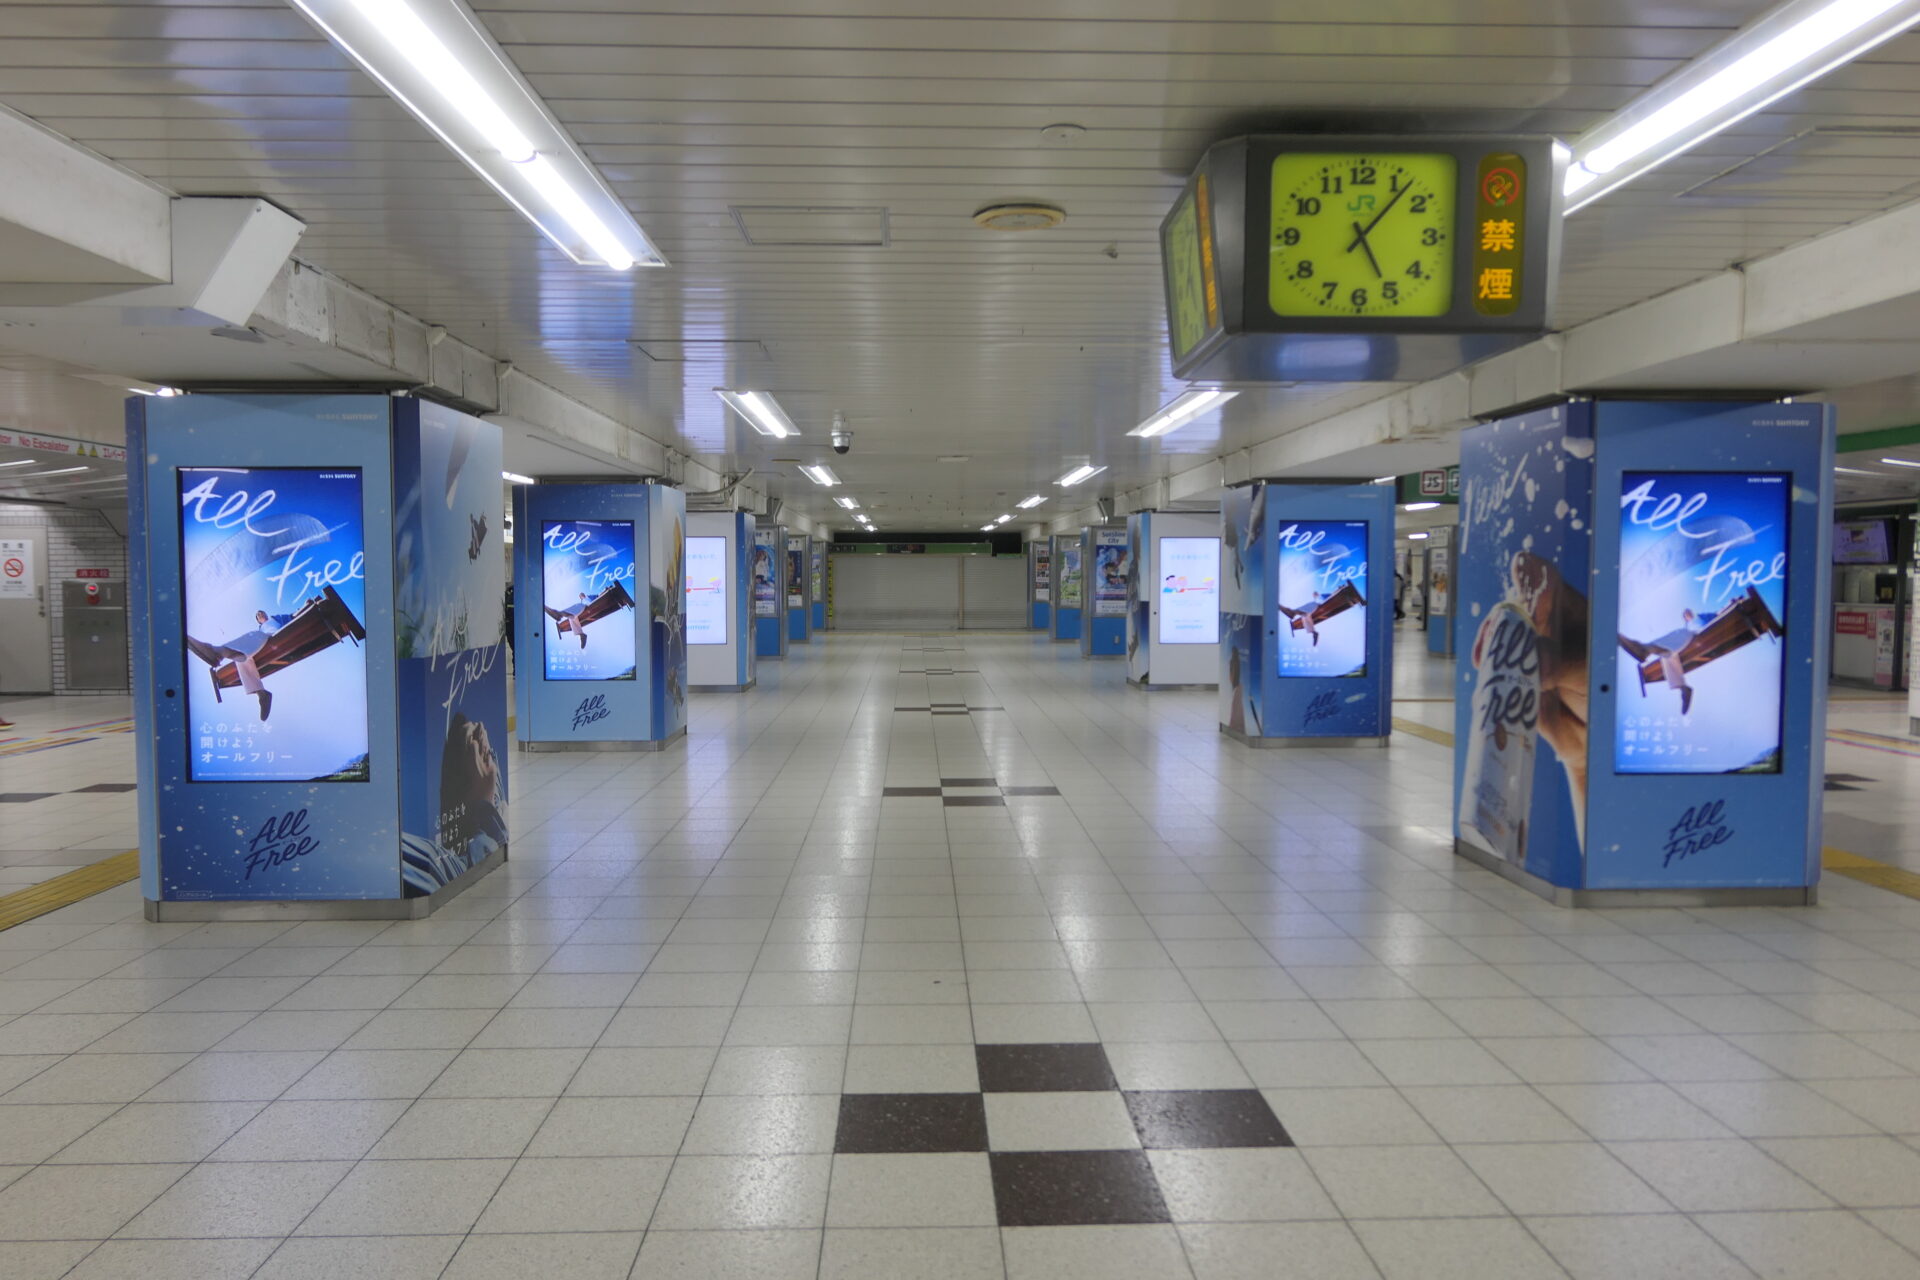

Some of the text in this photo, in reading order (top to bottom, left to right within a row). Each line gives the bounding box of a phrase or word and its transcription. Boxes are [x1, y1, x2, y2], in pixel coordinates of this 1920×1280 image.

[1320, 176, 1343, 195] 11
[1350, 166, 1377, 186] 12
[1389, 174, 1400, 193] 1
[1296, 197, 1321, 217] 10
[1346, 194, 1376, 212] JR
[1409, 195, 1428, 213] 2
[1283, 227, 1301, 246] 9
[1421, 228, 1439, 247] 3
[1296, 260, 1314, 279] 8
[1405, 260, 1423, 279] 4
[1479, 218, 1516, 301] 禁煙
[1321, 282, 1339, 301] 7
[1351, 288, 1368, 307] 6
[1382, 281, 1399, 300] 5
[18, 436, 70, 452] No Escalator
[182, 476, 296, 537] All
[1620, 479, 1725, 539] All
[543, 524, 600, 556] All
[1278, 524, 1332, 556] All
[265, 521, 365, 607] Free
[584, 547, 635, 591] Free
[1319, 547, 1368, 589] Free
[1694, 523, 1787, 604] Free
[575, 694, 606, 717] All
[200, 722, 273, 735] 心のふたを
[571, 708, 611, 732] Free
[200, 736, 255, 749] 開けよう
[1624, 744, 1709, 757] オールフリー
[201, 751, 293, 764] オールフリー
[249, 808, 310, 852] All
[1669, 799, 1727, 841] All
[1662, 825, 1736, 869] Free
[243, 836, 321, 881] Free
